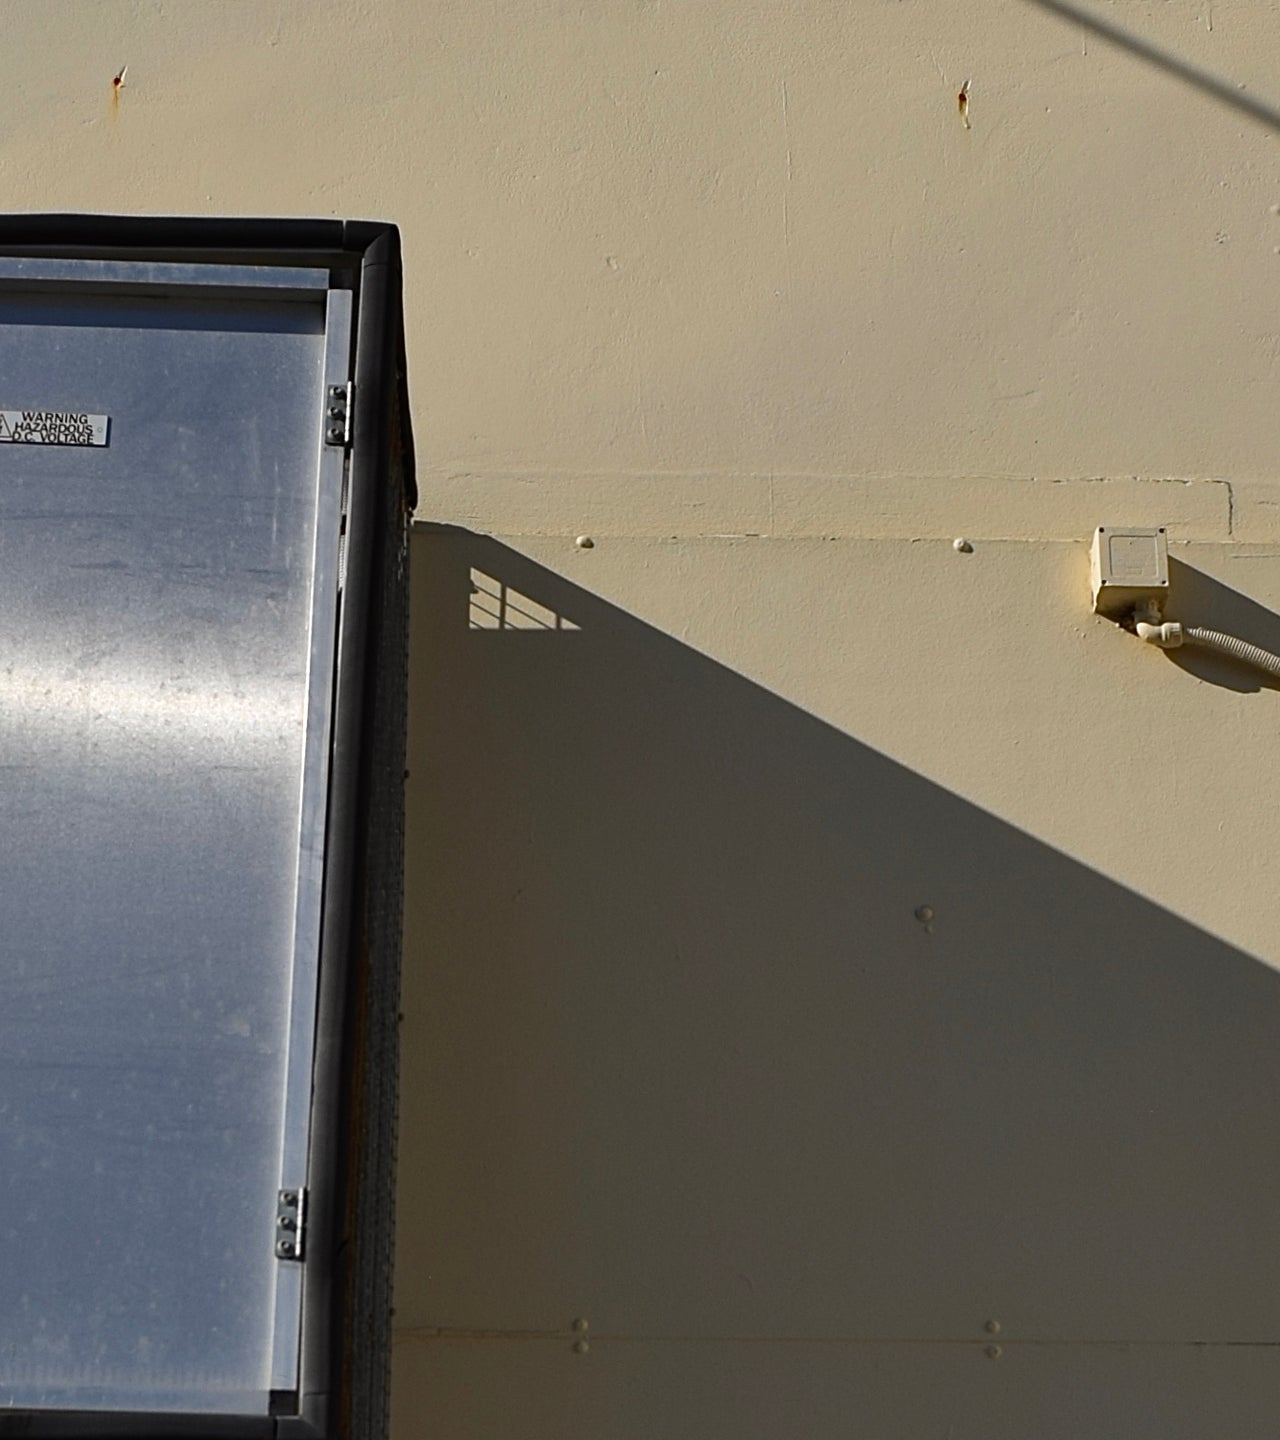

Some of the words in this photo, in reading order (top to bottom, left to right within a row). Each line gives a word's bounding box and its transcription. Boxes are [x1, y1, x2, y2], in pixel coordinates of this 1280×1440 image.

[22, 411, 88, 425] WARNING
[15, 422, 93, 435] HAZARDOUS
[41, 432, 94, 445] VOLTAGE
